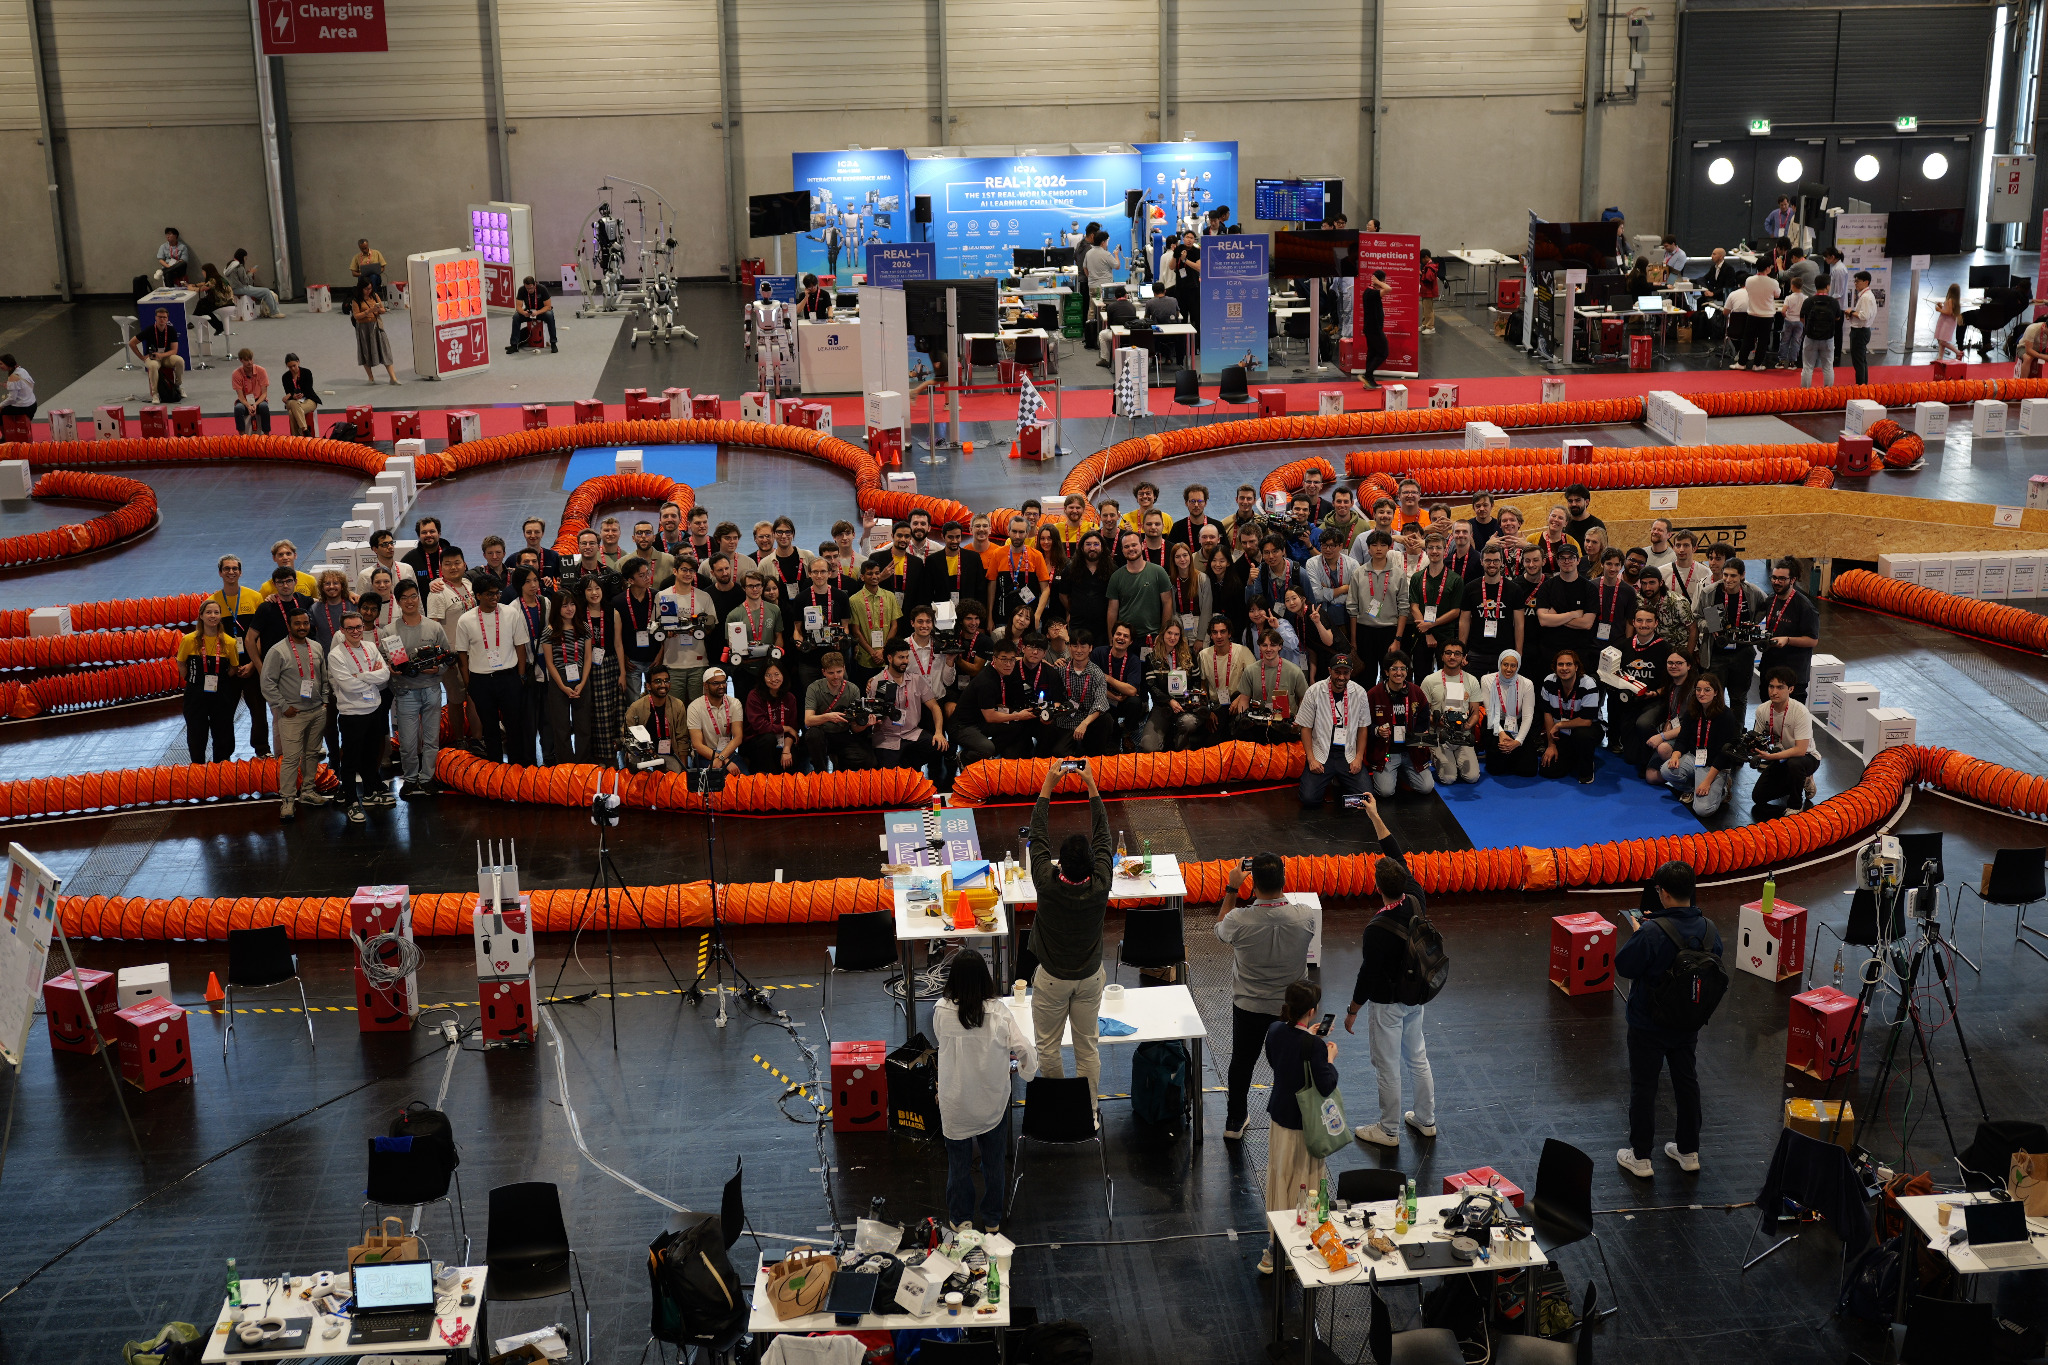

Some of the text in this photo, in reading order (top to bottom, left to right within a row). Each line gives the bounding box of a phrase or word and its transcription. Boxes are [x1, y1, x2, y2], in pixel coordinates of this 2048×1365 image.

[299, 3, 374, 20] Charging
[318, 26, 358, 39] Area
[1013, 165, 1038, 173] ICRA
[984, 175, 1067, 189] REAL-I 2026
[997, 190, 1046, 199] REAL-WORLD
[1049, 189, 1088, 197] EMBODIED
[1029, 198, 1074, 206] CHALLENGE
[1217, 240, 1253, 251] REAL-I
[883, 248, 920, 259] REAL-I
[1226, 252, 1245, 260] 2026
[1360, 250, 1415, 260] Competition 5
[892, 260, 912, 268] 2026
[1666, 529, 1747, 548] KAPP
[560, 557, 574, 567] tu
[1627, 669, 1655, 679] VAUL
[900, 842, 917, 867] KNAP
[951, 839, 968, 862] NAPP
[1553, 945, 1569, 955] ICRA
[1792, 1026, 1811, 1036] ICRA
[120, 1041, 138, 1049] ICRA
[897, 1109, 925, 1126] BILLA
